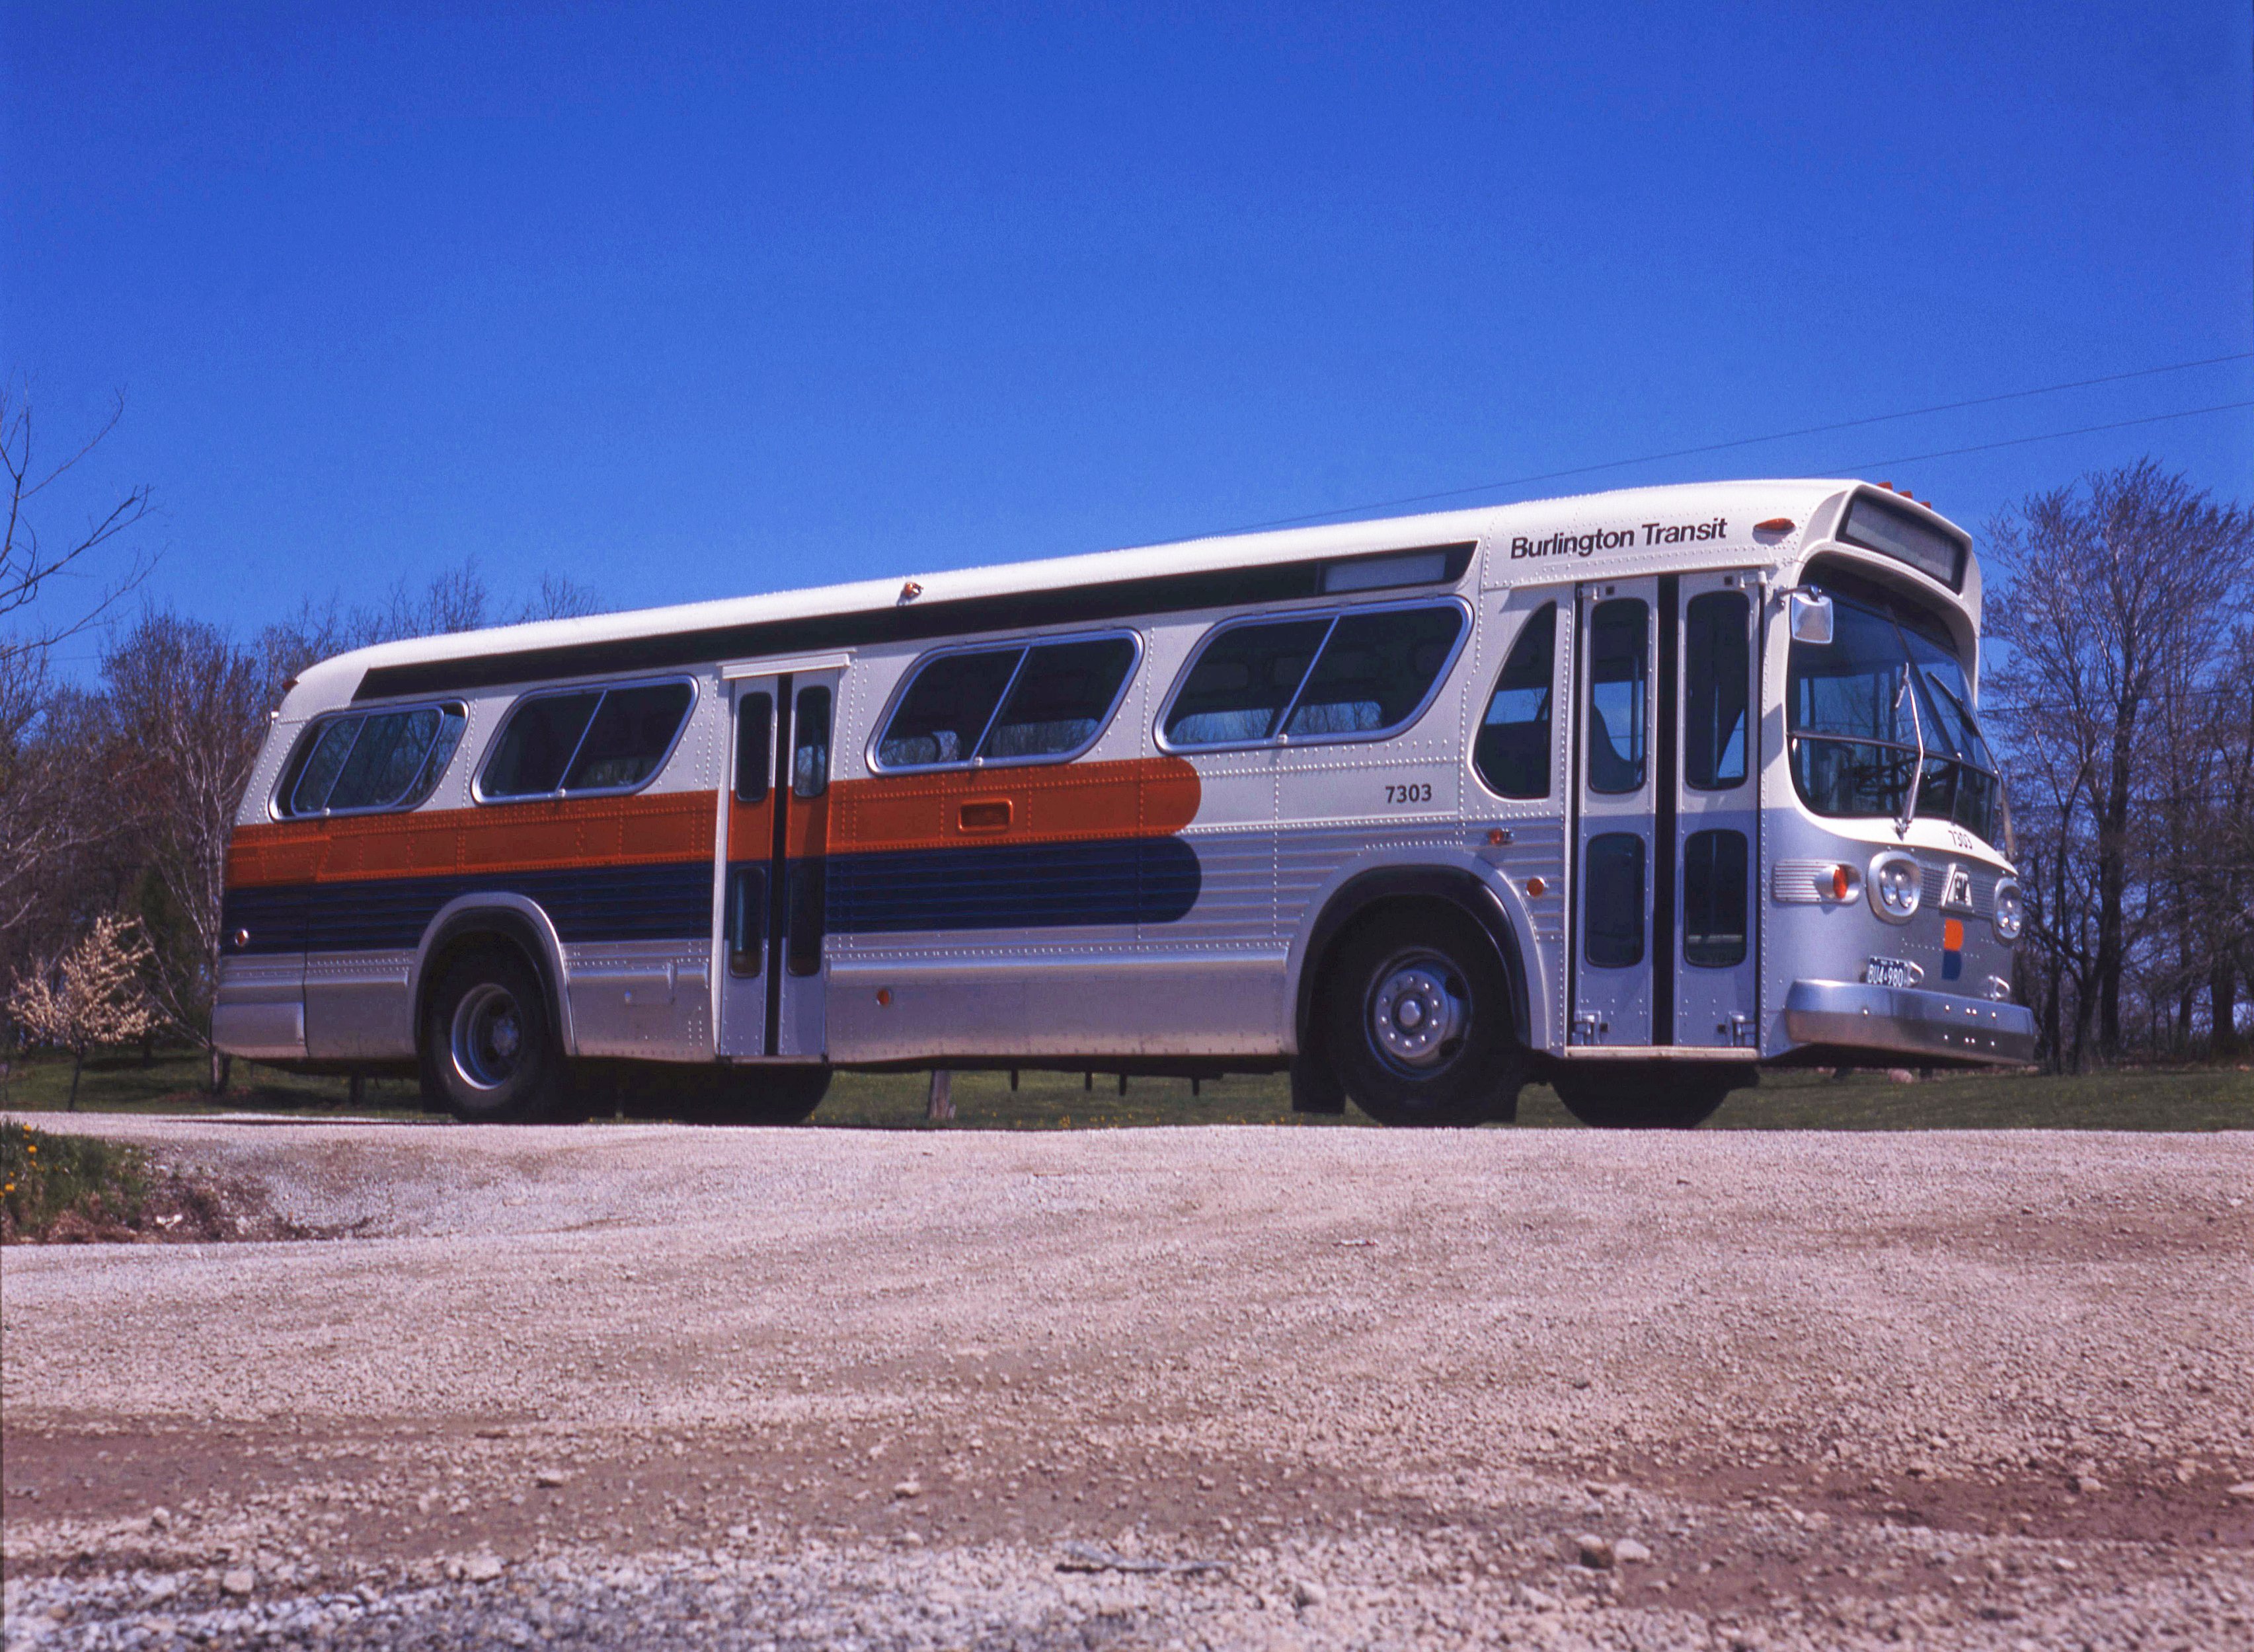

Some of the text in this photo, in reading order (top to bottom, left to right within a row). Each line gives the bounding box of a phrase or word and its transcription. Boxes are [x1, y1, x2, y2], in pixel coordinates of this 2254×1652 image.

[1510, 517, 1728, 559] Burlington Transit
[1385, 784, 1432, 804] 7303
[1948, 830, 1972, 850] 7303
